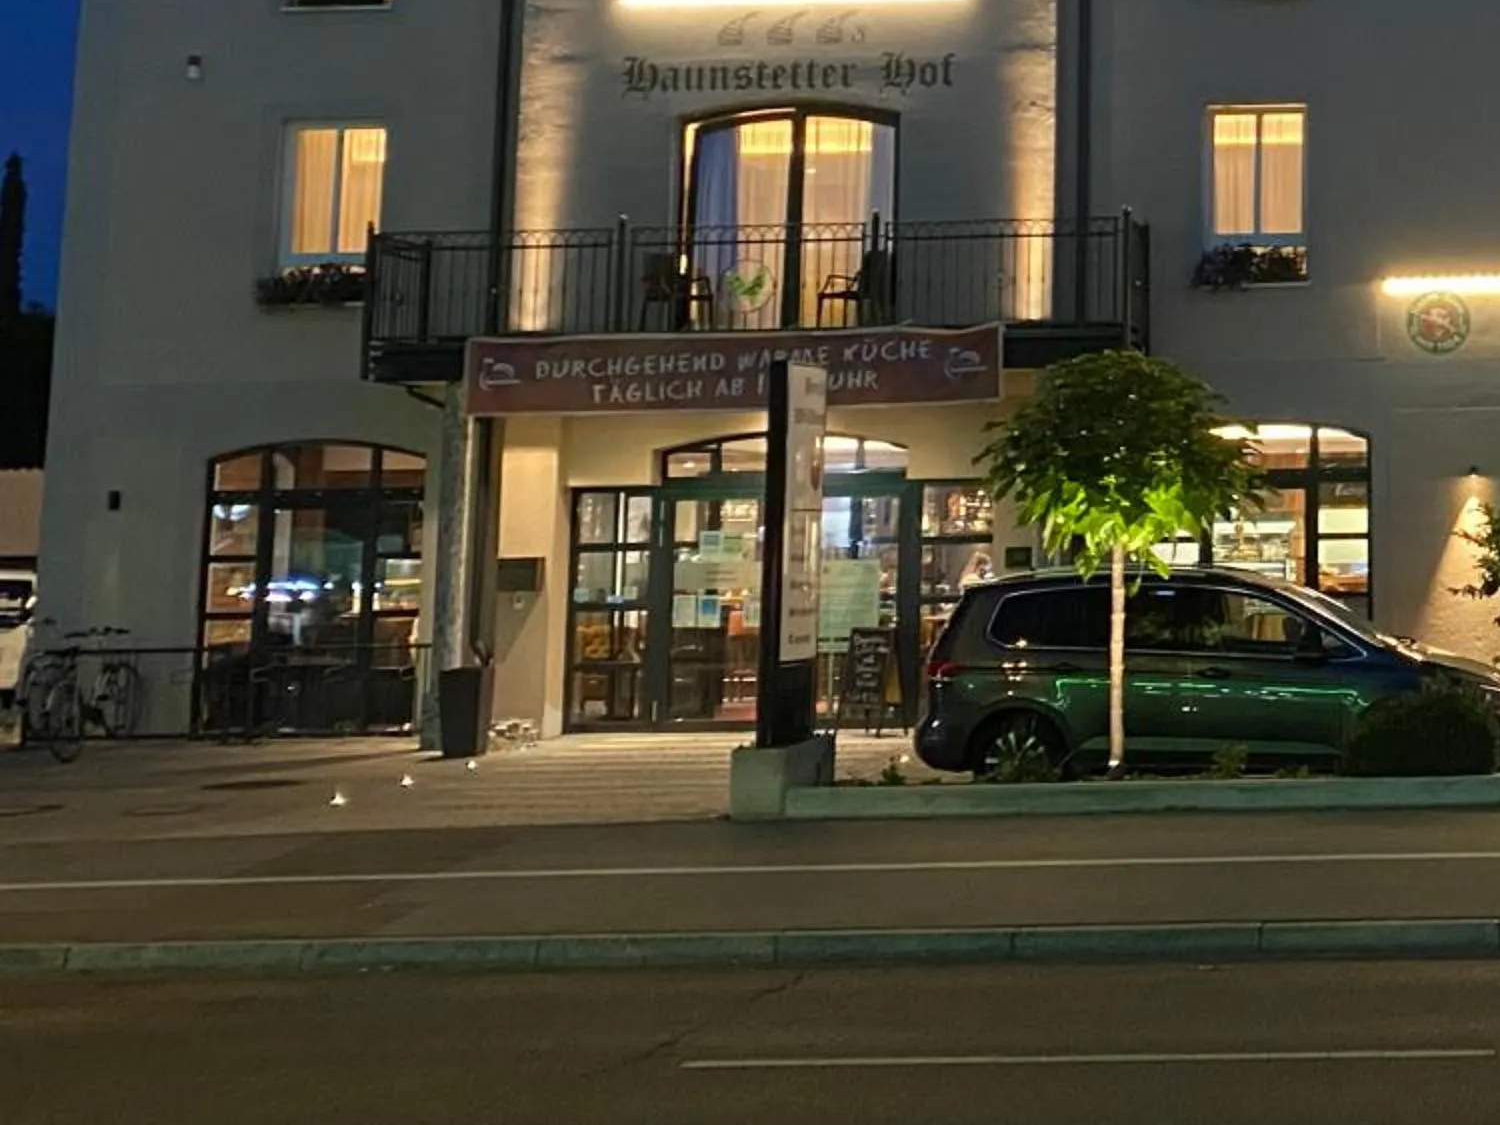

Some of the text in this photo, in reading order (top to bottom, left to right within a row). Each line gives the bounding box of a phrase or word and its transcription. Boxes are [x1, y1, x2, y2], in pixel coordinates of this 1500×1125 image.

[621, 52, 957, 100] Haunstetter Hof
[536, 352, 725, 380] DURCHGEHEND
[843, 338, 933, 364] KÜCHE
[592, 377, 703, 404] TÄGLICH
[714, 377, 745, 398] AB
[828, 369, 879, 391] UHR
